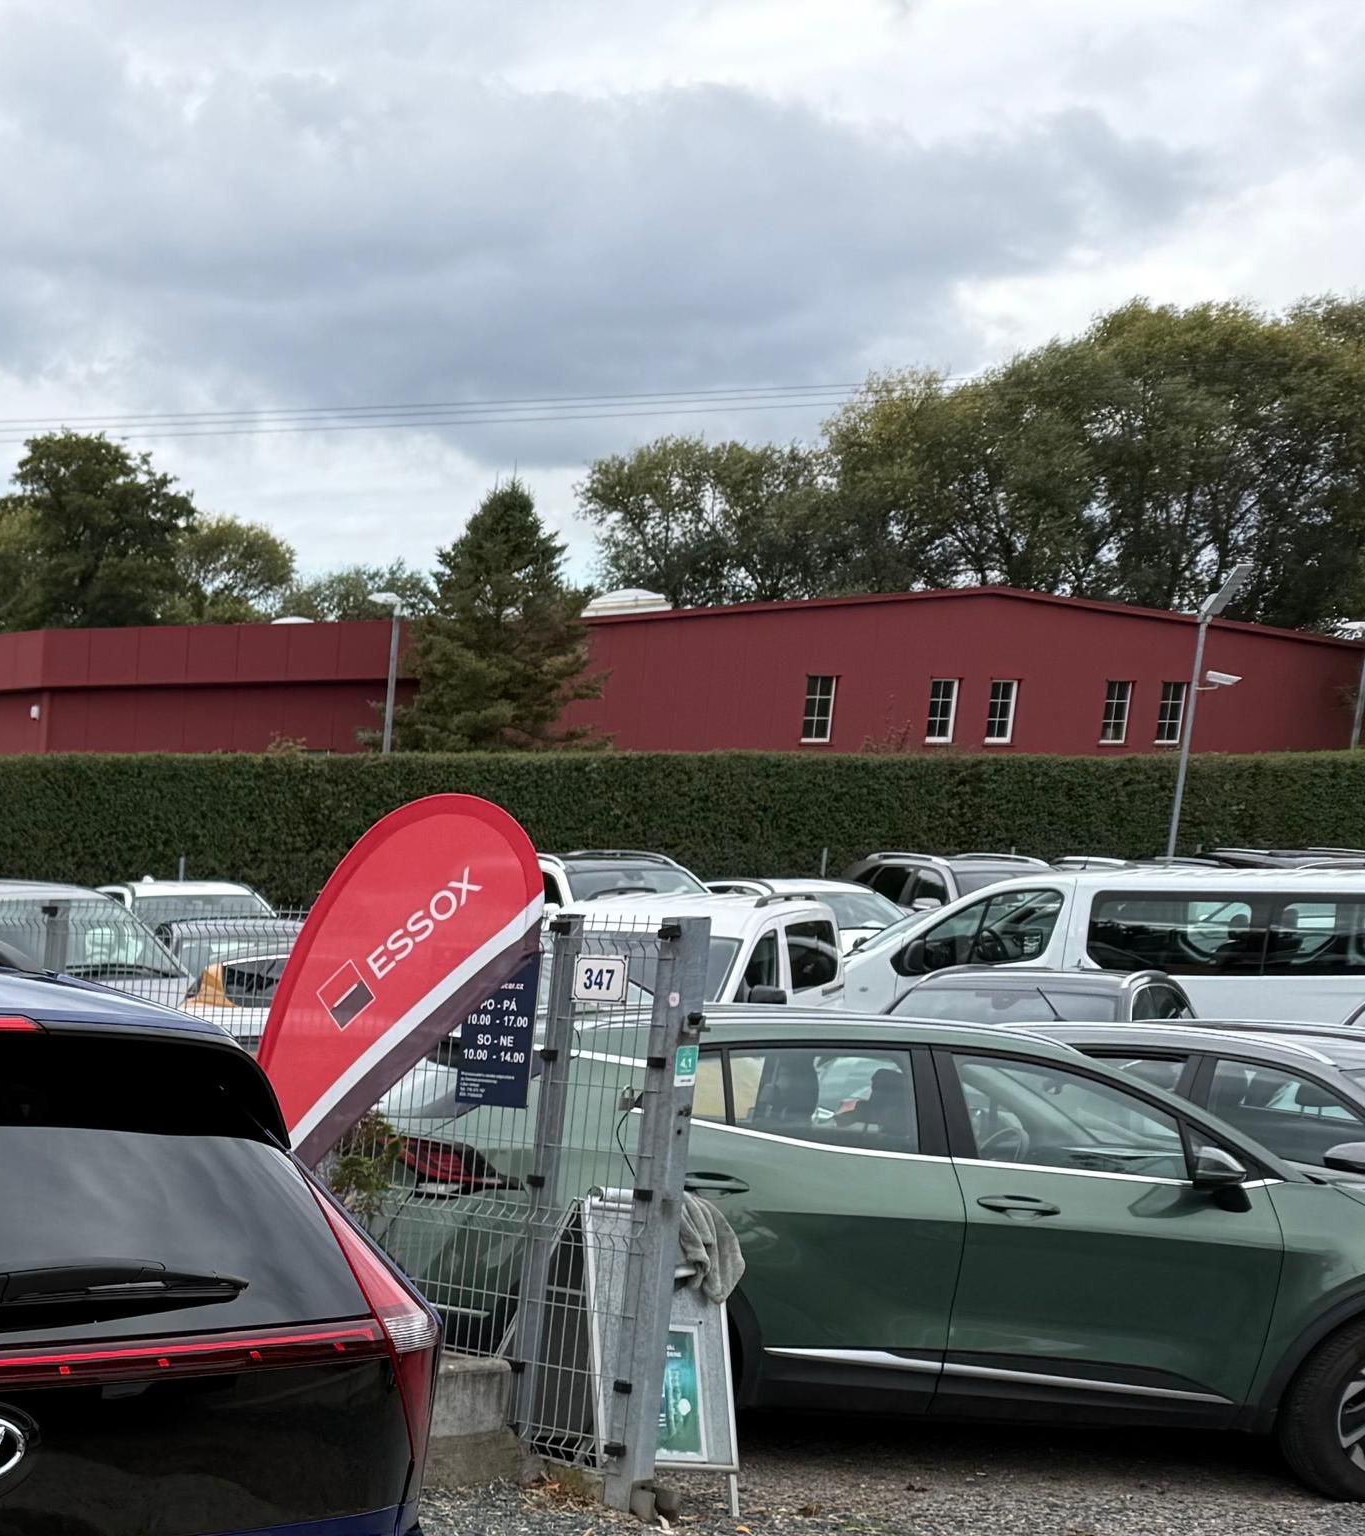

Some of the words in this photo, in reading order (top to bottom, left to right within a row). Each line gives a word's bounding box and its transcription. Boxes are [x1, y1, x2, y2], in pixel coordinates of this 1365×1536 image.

[366, 866, 483, 980] ESSOX
[583, 967, 615, 991] 347
[502, 997, 517, 1011] PÁ
[503, 1015, 528, 1028] 17.00
[477, 1033, 492, 1046] SO
[499, 1034, 514, 1047] NE
[463, 1048, 488, 1061] 10.00
[500, 1050, 525, 1064] 14.00
